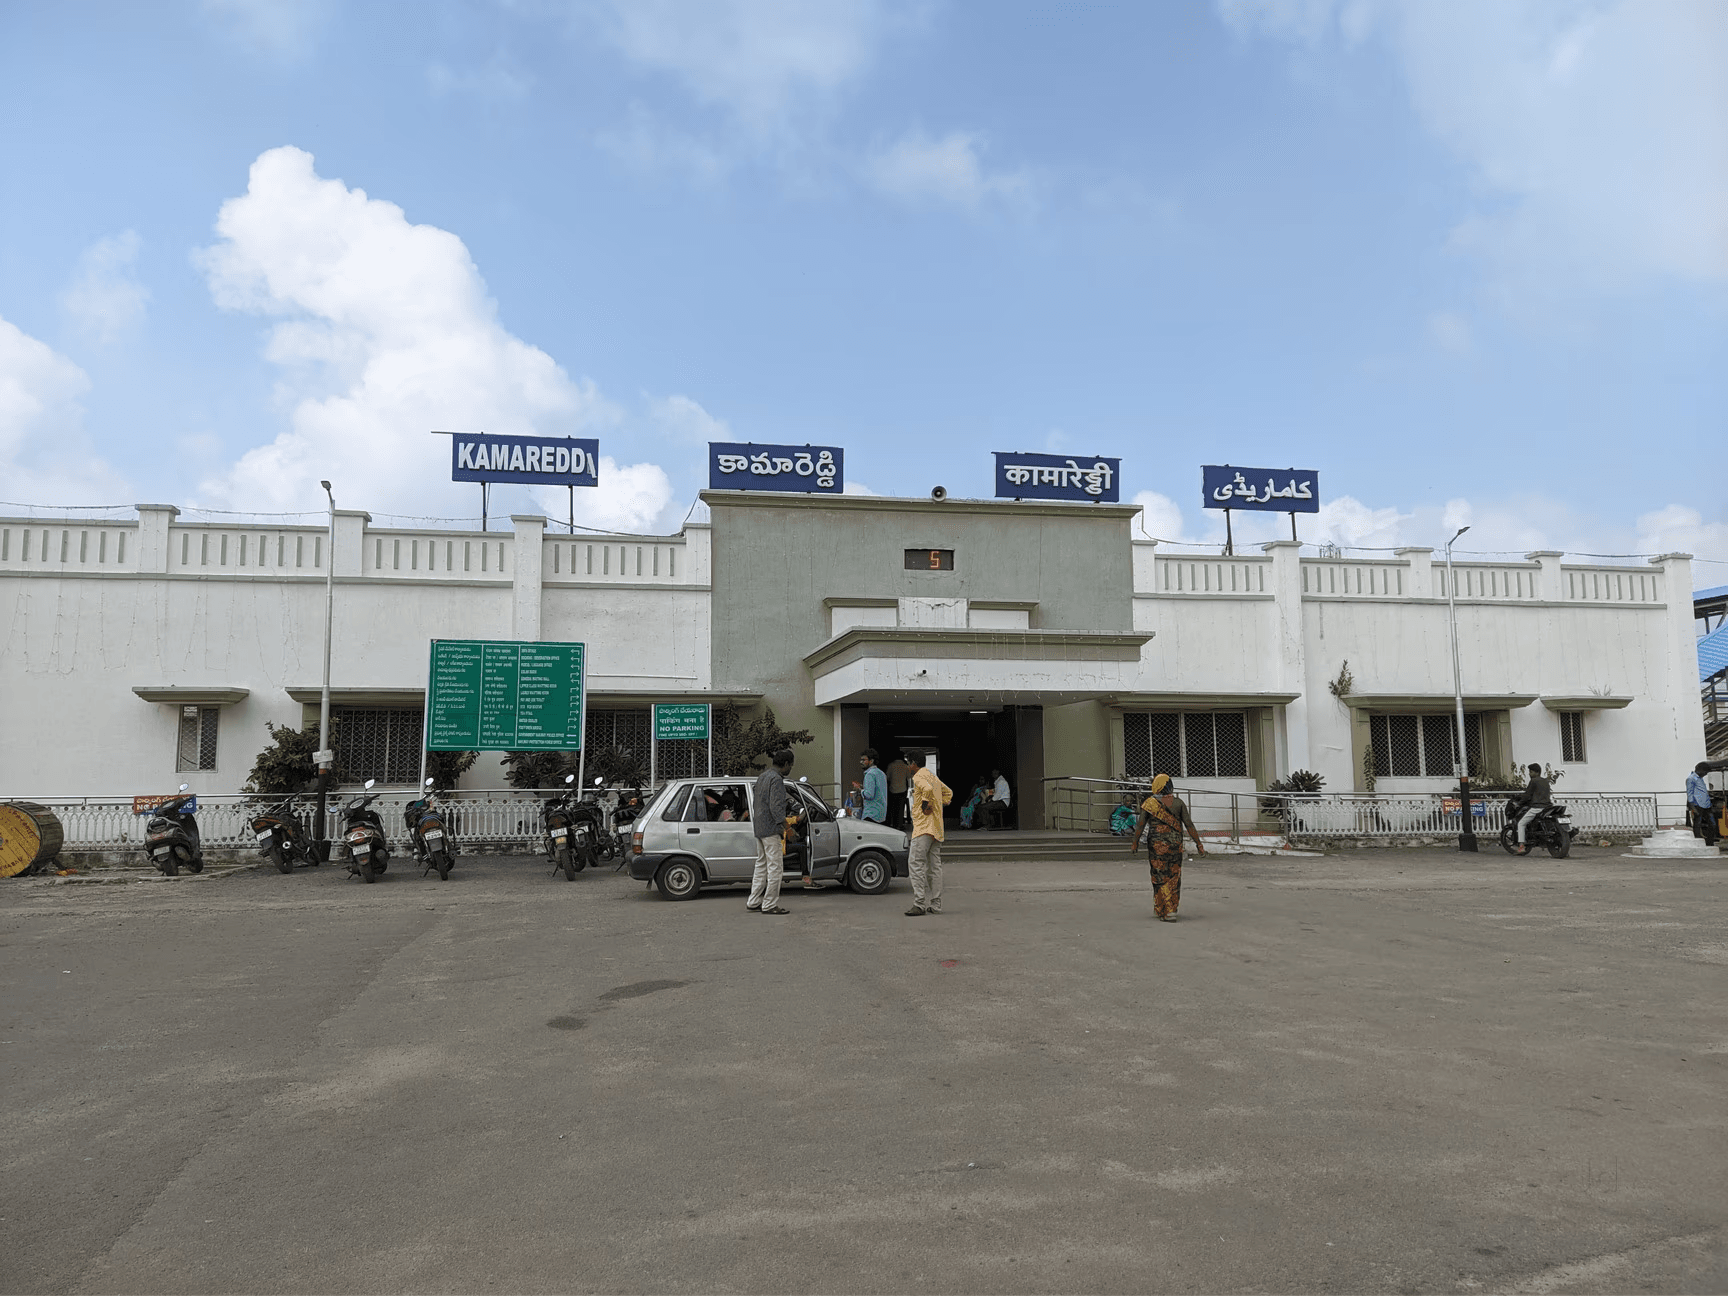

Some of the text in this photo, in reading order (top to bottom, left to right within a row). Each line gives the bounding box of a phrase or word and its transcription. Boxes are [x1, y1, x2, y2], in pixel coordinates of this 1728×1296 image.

[717, 450, 837, 488] కామారెడ్డి
[1003, 459, 1114, 495] कामारेड्डी
[1213, 471, 1313, 503] کاماریڈی
[930, 550, 940, 569] 5
